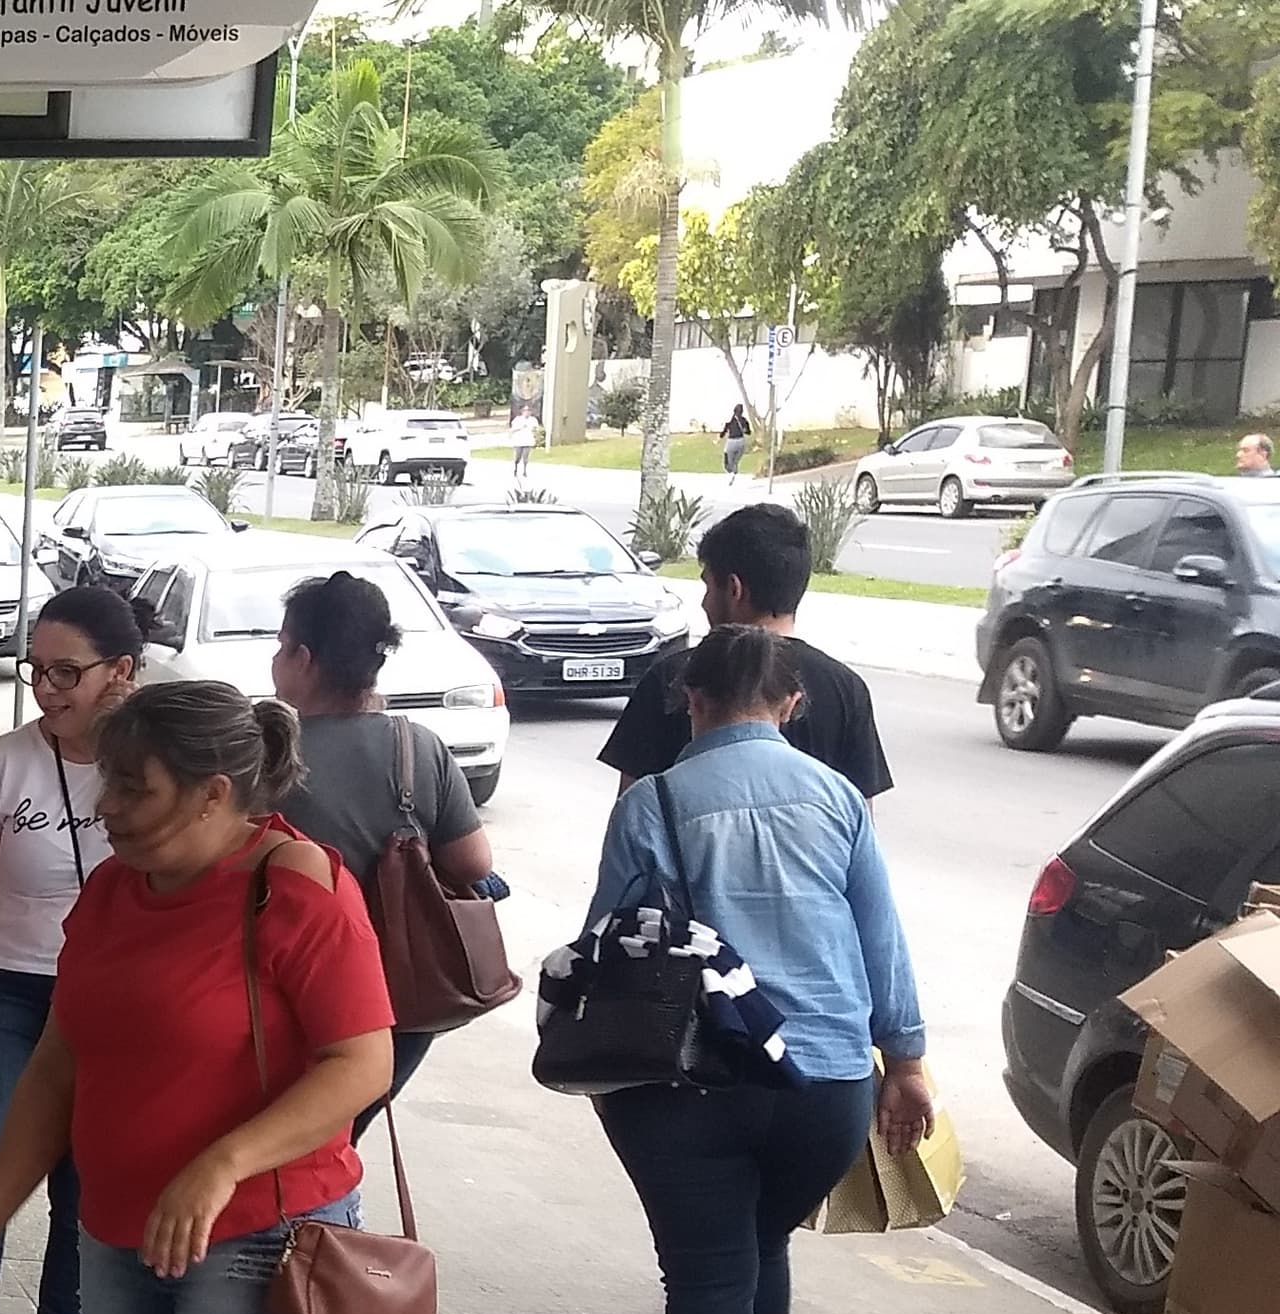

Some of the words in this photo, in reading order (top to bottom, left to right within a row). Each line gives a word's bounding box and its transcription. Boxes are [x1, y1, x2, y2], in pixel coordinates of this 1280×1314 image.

[56, 25, 150, 46] Calçados
[169, 25, 239, 42] Móveis
[781, 331, 789, 343] E
